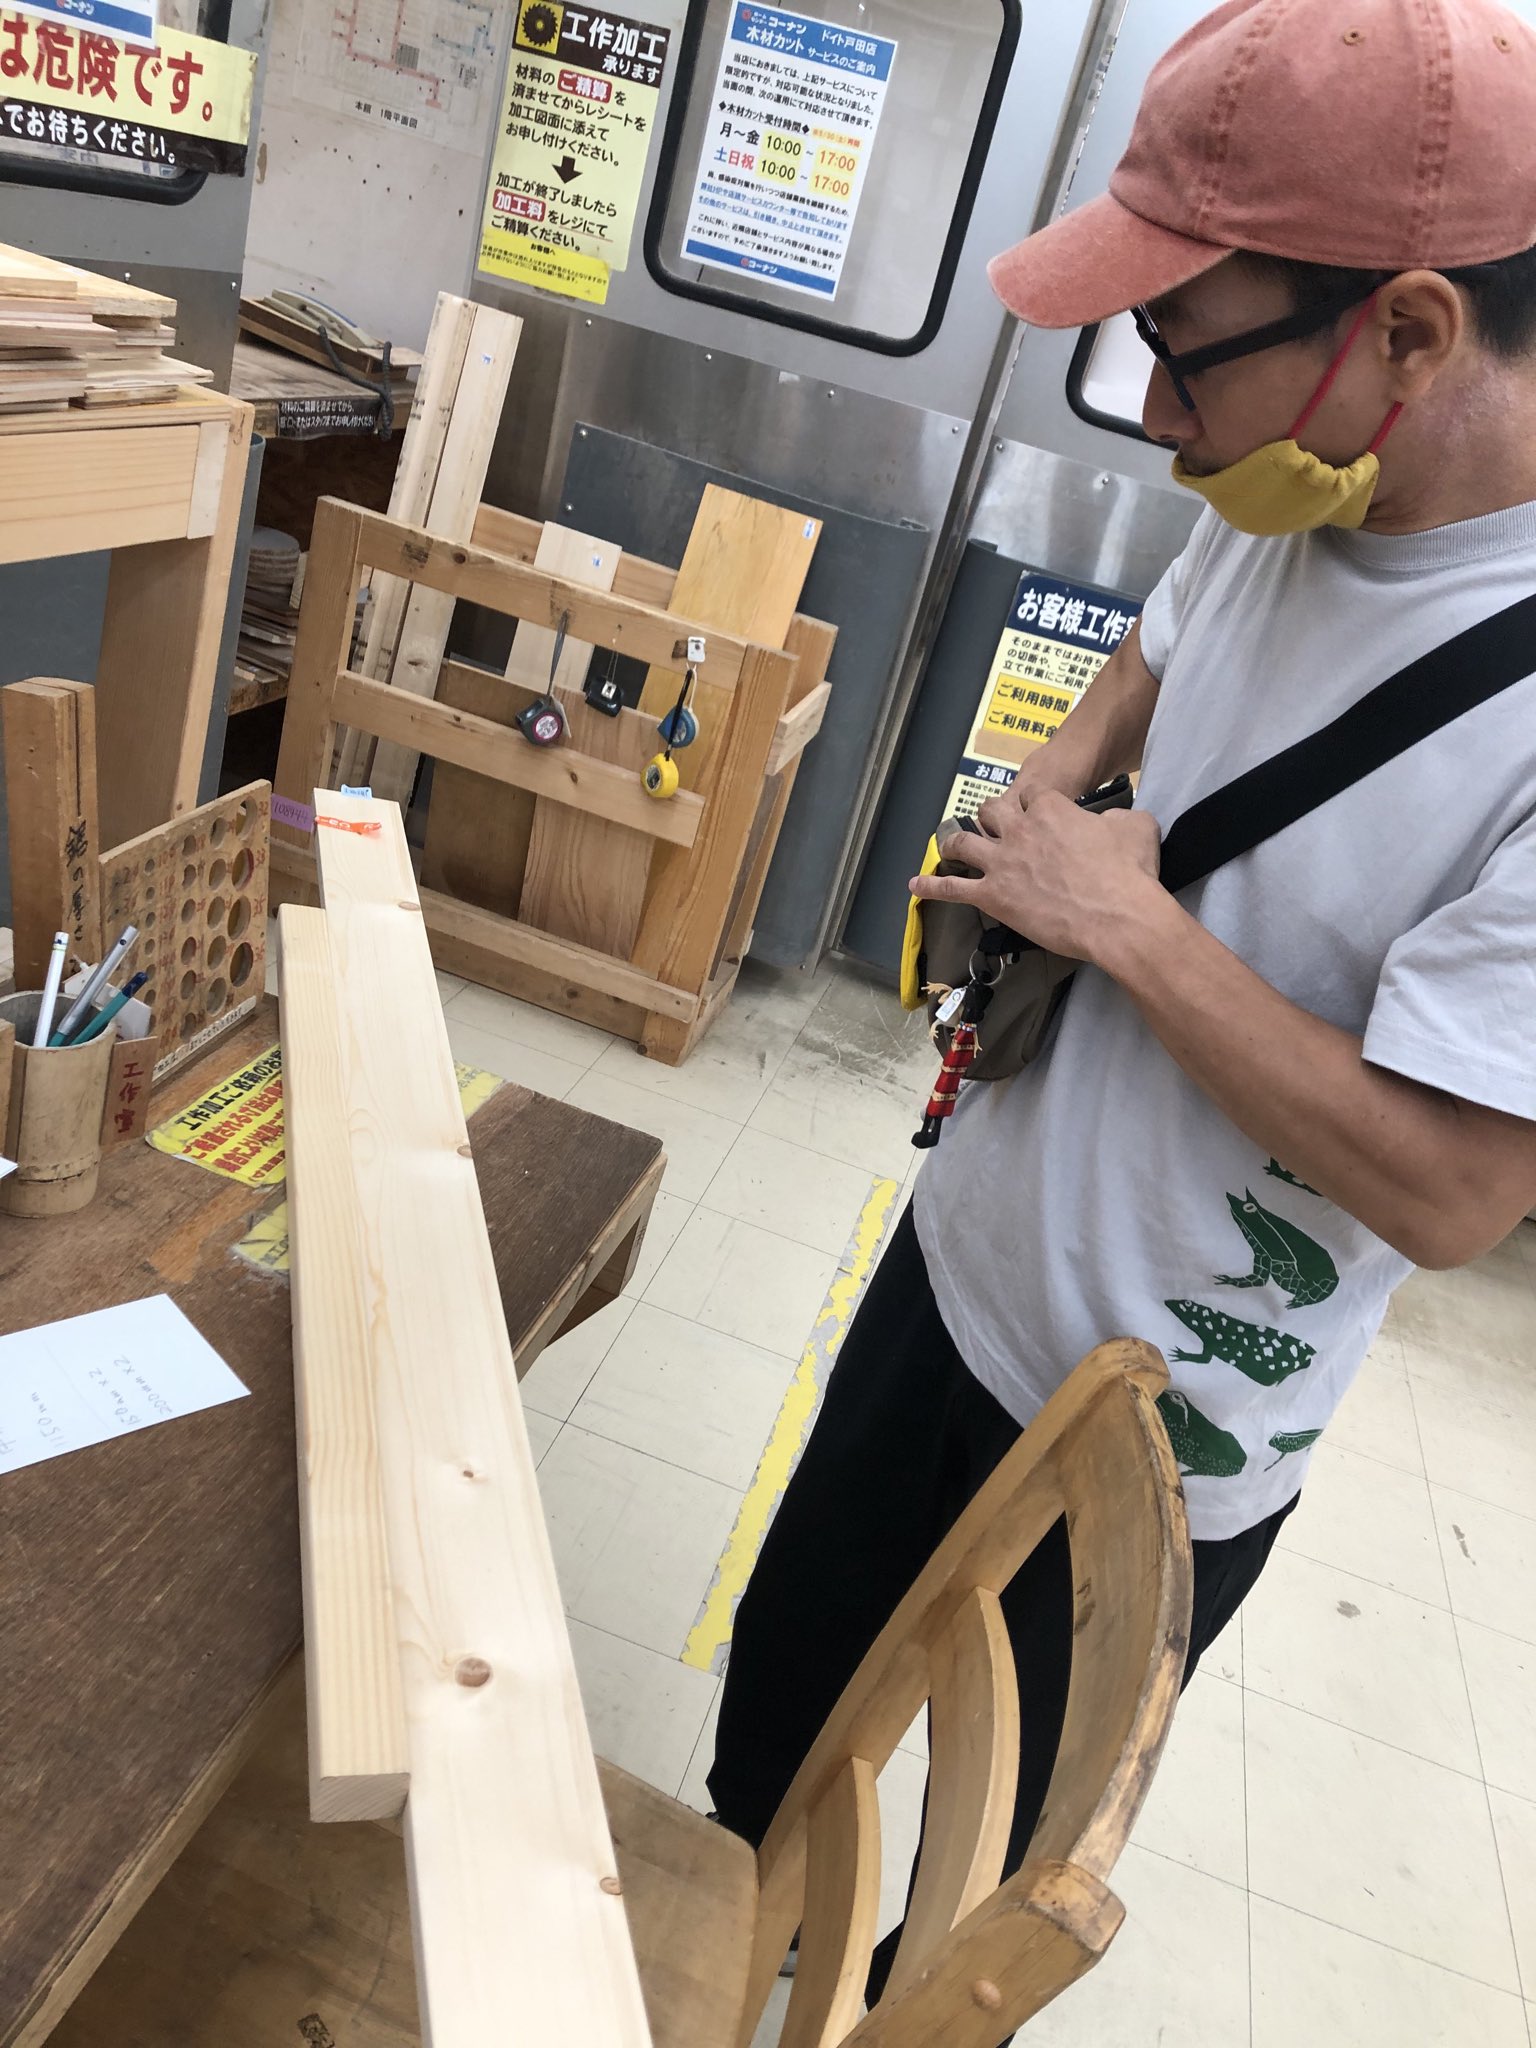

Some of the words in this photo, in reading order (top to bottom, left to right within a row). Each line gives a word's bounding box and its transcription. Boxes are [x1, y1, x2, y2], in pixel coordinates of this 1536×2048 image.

[561, 11, 666, 65] 工作加工
[746, 25, 804, 53] 木材カット
[807, 46, 876, 75] サービスのご案内
[768, 14, 807, 34] コーナン
[822, 27, 878, 56] ドイト戸田店
[516, 62, 555, 86] 材料の
[559, 71, 609, 101] ご精算
[615, 90, 627, 106] を
[602, 55, 660, 83] 承ります
[508, 102, 610, 142] 加工図面に添えて
[512, 82, 647, 132] 済ませてからレシートを
[0, 104, 175, 164] でお待ちください。
[506, 122, 619, 166] お申し付けください。
[767, 135, 801, 156] 10:00
[819, 150, 855, 172] 17:00
[714, 147, 755, 170] 土日祝
[761, 160, 796, 181] 10:00
[814, 175, 850, 196] 17:00
[495, 191, 543, 218] 加工料
[548, 209, 608, 237] をレジにて
[496, 172, 617, 217] 加工が終了しましたら
[492, 215, 581, 251] ご精算ください。
[748, 261, 777, 275] コーナン
[1012, 637, 1103, 668] そのままではお持ち
[997, 682, 1069, 713] ご利用時間
